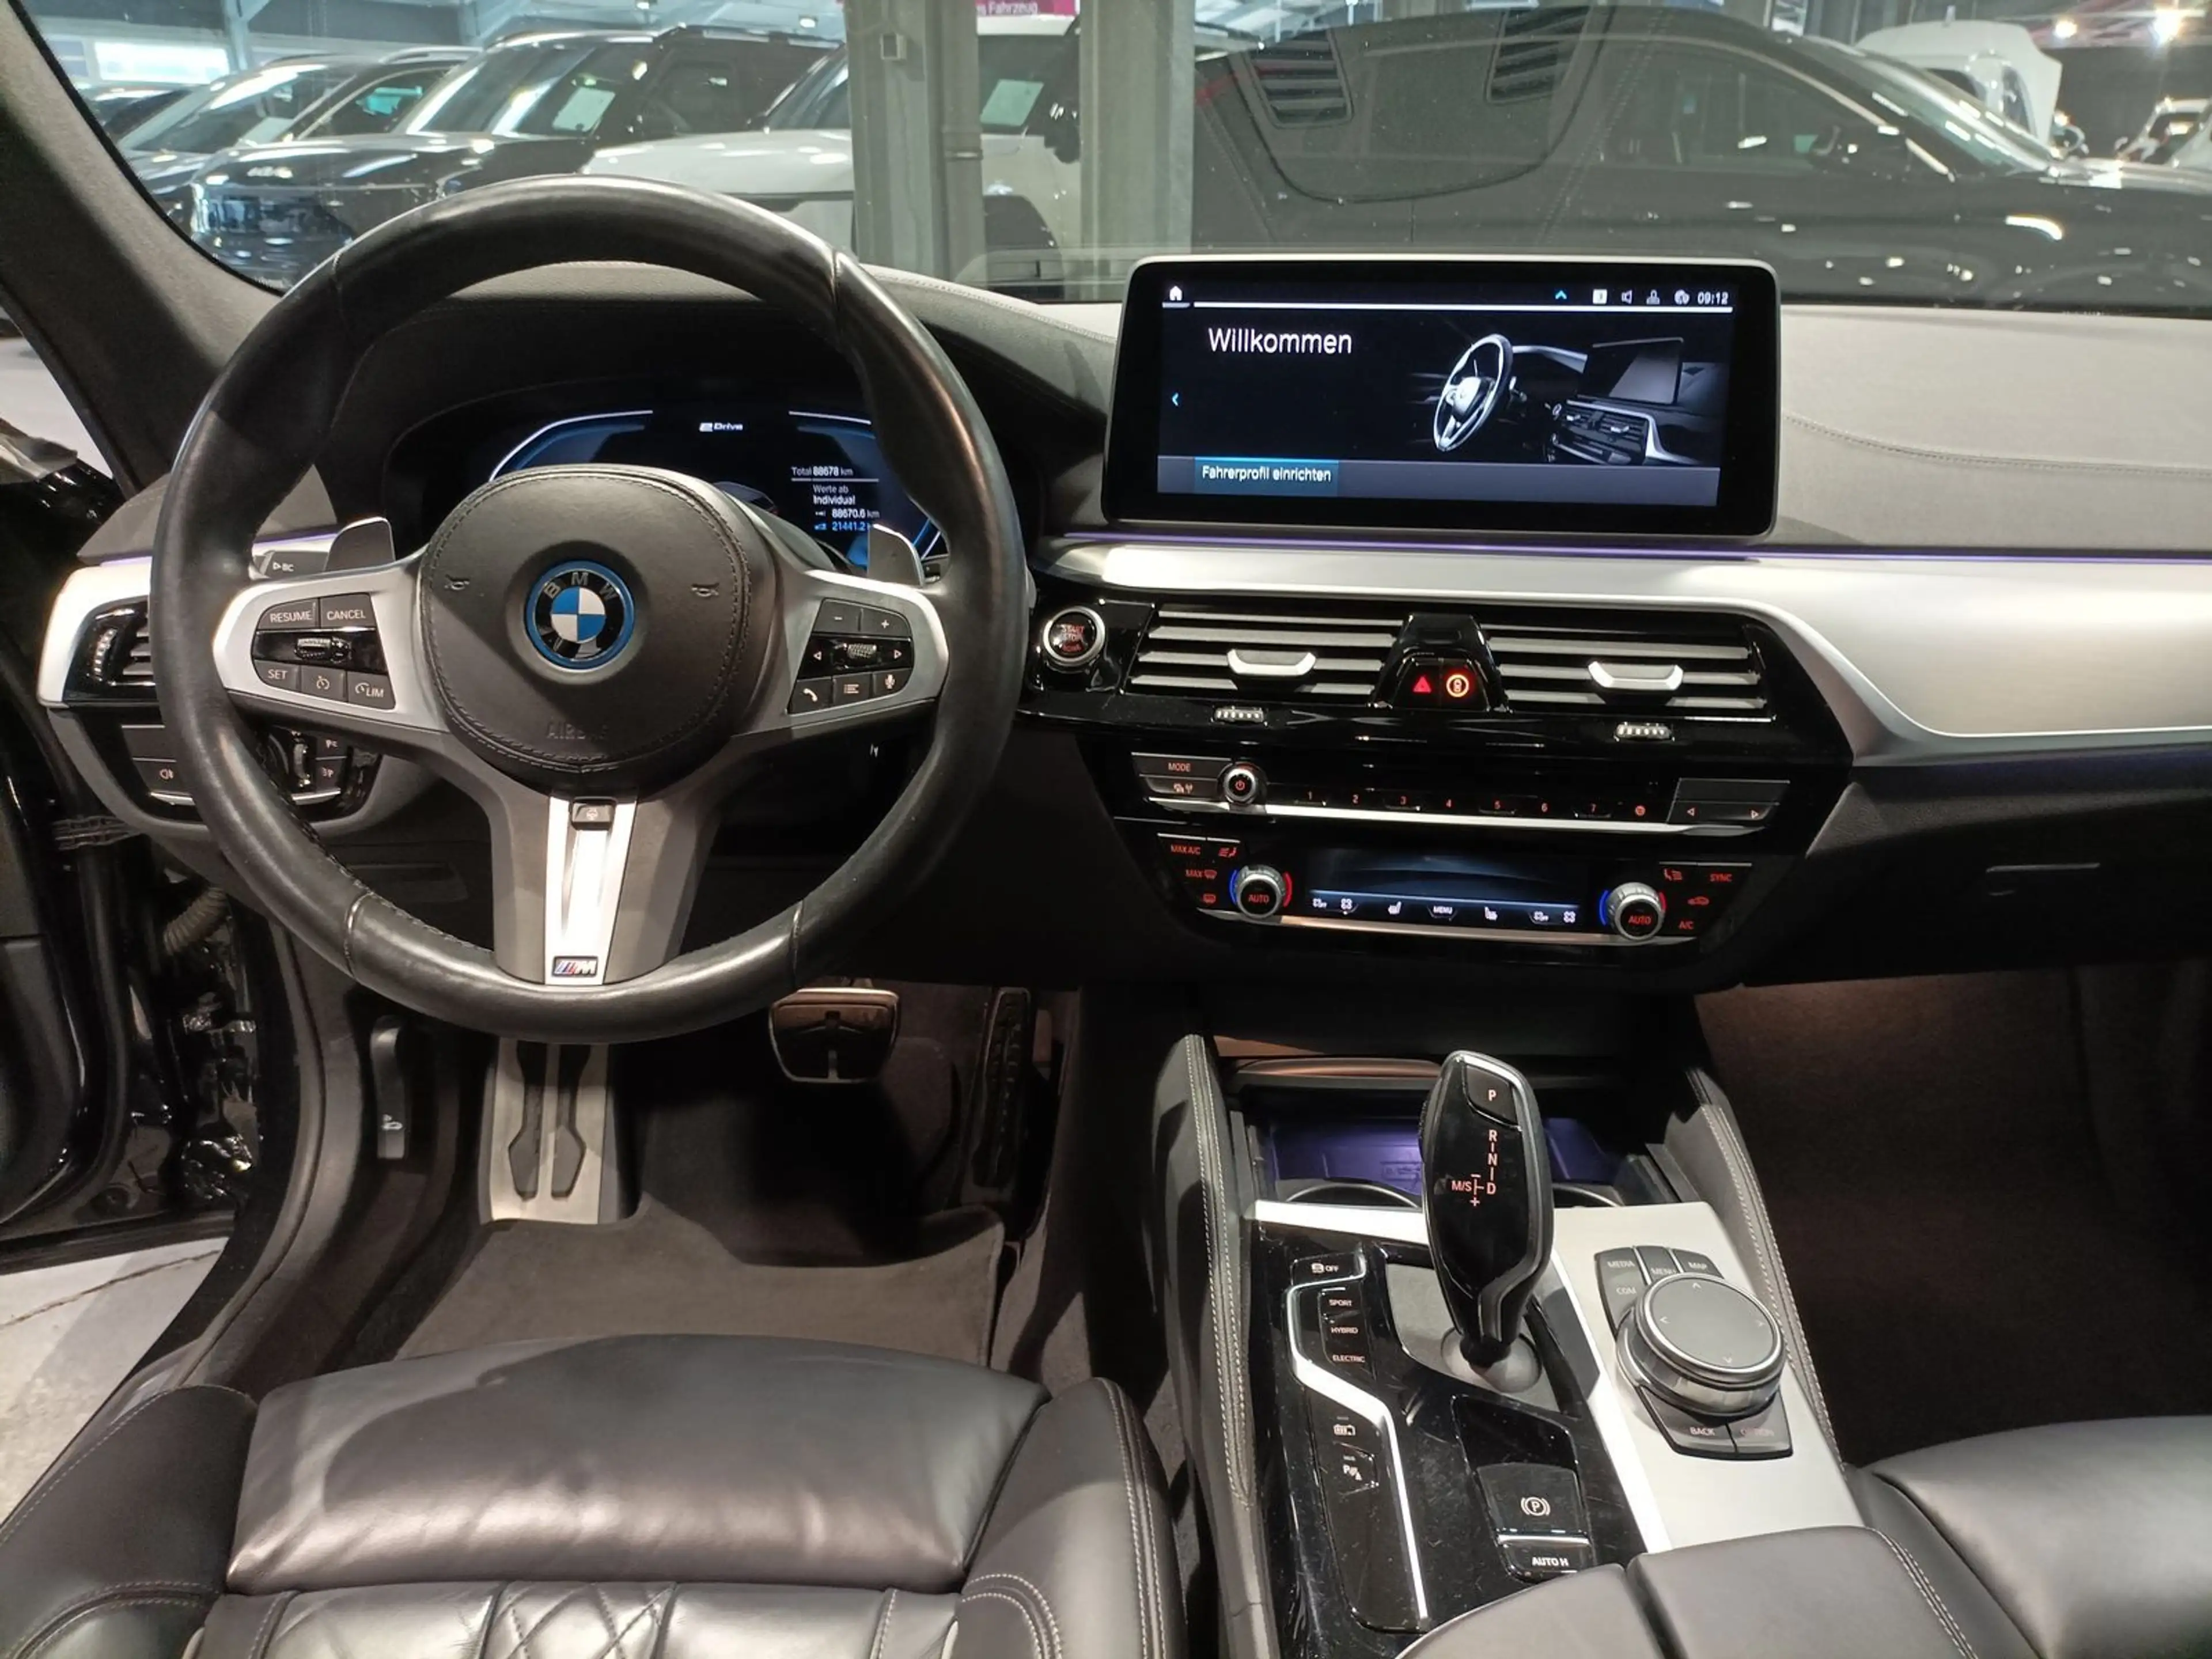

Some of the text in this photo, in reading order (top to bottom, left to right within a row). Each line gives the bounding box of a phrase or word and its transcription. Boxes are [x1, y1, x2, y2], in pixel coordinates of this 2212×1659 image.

[1697, 291, 1729, 305] 09:12
[1208, 328, 1352, 354] Willkommen
[791, 467, 812, 476] Total
[840, 467, 854, 476] km
[1202, 465, 1331, 482] Fahrerprofil einrichten
[813, 484, 849, 494] Werte ab
[813, 495, 856, 505] Individual
[544, 571, 619, 600] BMW
[270, 610, 313, 623] RESUME
[327, 609, 366, 621] CANCEL
[267, 669, 288, 680] SET
[366, 685, 384, 698] LIM
[1168, 762, 1191, 772] MODE
[1308, 791, 1313, 801] 1
[1353, 794, 1359, 804] 2
[1446, 799, 1452, 808] 4
[1541, 802, 1548, 812] 6
[1171, 843, 1187, 853] MAX
[1710, 873, 1733, 882] SYNC
[1248, 894, 1270, 904] AUTO
[1433, 906, 1453, 915] MENU
[1628, 915, 1652, 925] AUTO
[1679, 921, 1694, 930] A/C
[1488, 1089, 1497, 1101] P
[1488, 1130, 1497, 1142] R
[1488, 1153, 1497, 1165] N
[1451, 1180, 1472, 1192] M/S
[1487, 1182, 1497, 1194] D
[1325, 1265, 1339, 1273] OFF
[1332, 1354, 1366, 1363] ELECTRIC
[1689, 1426, 1715, 1436] BACK
[1532, 1556, 1569, 1566] AUTO H
